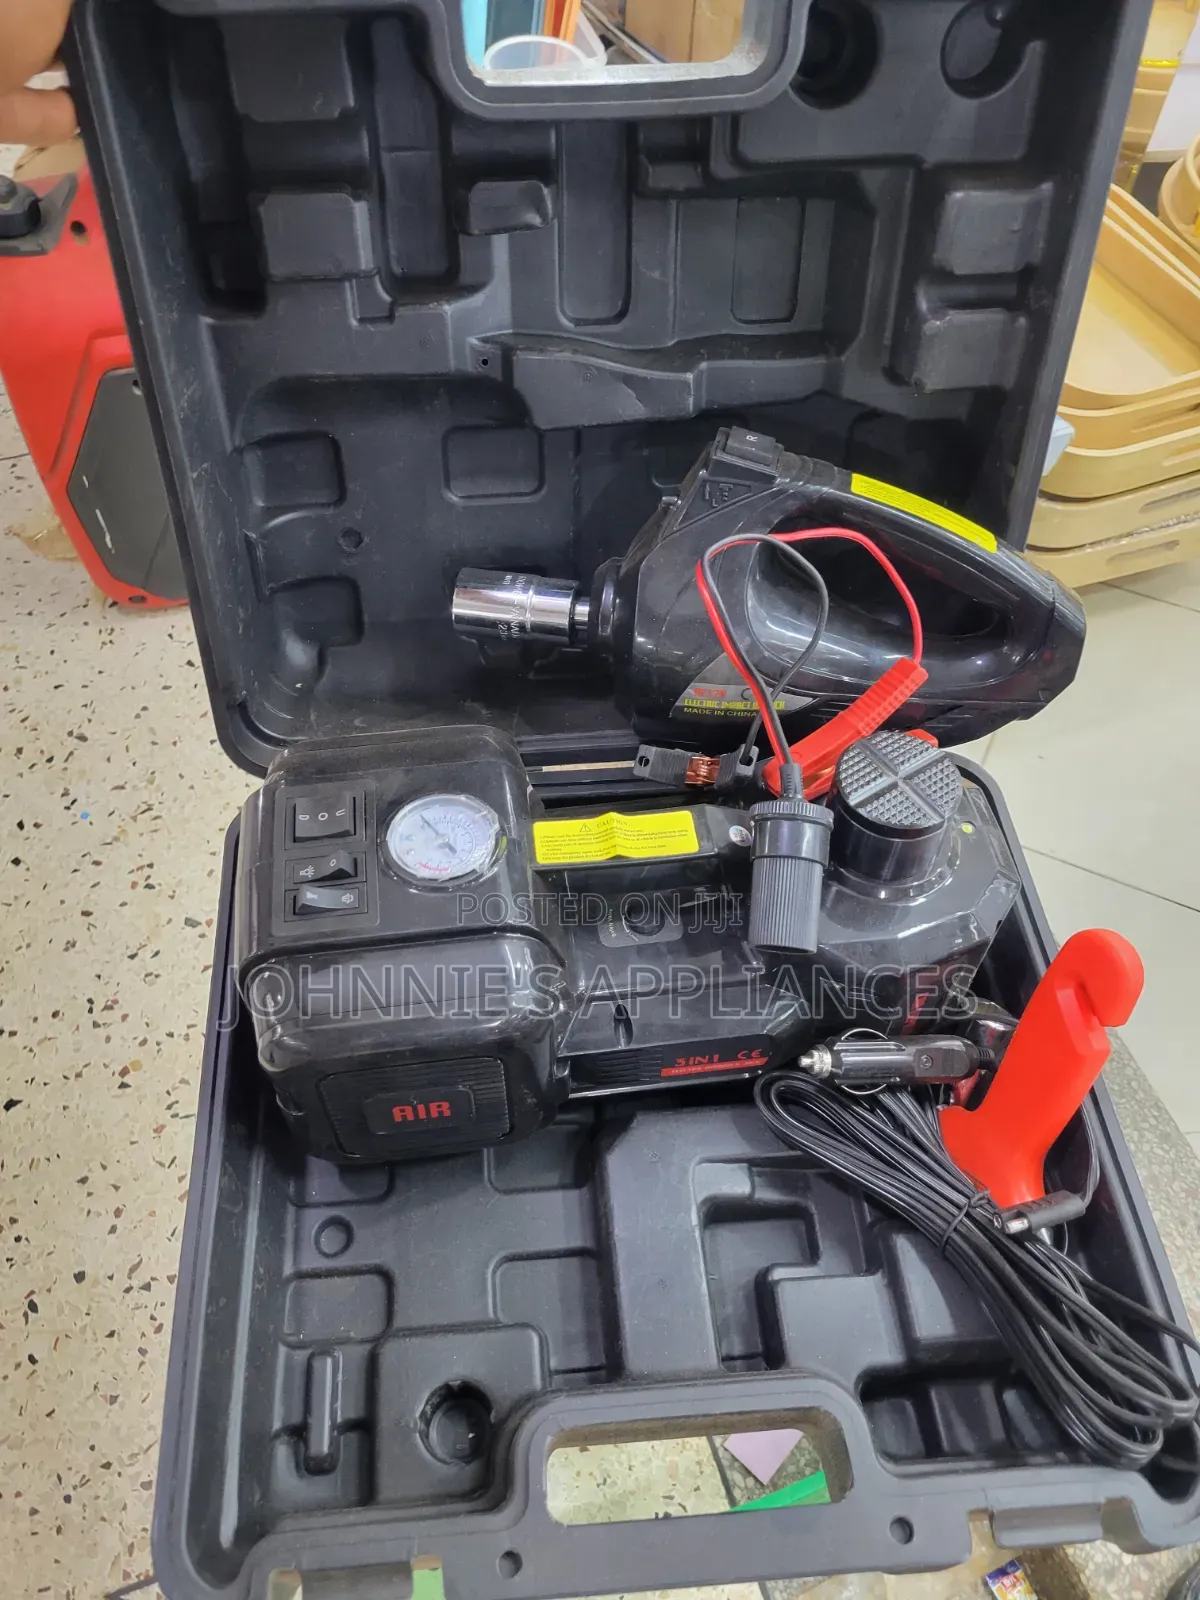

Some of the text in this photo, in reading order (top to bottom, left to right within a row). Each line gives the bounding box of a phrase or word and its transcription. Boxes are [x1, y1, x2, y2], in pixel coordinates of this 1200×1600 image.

[683, 706, 757, 717] MADE IN CHINA
[738, 1048, 762, 1060] CE
[392, 1101, 451, 1122] AIR
